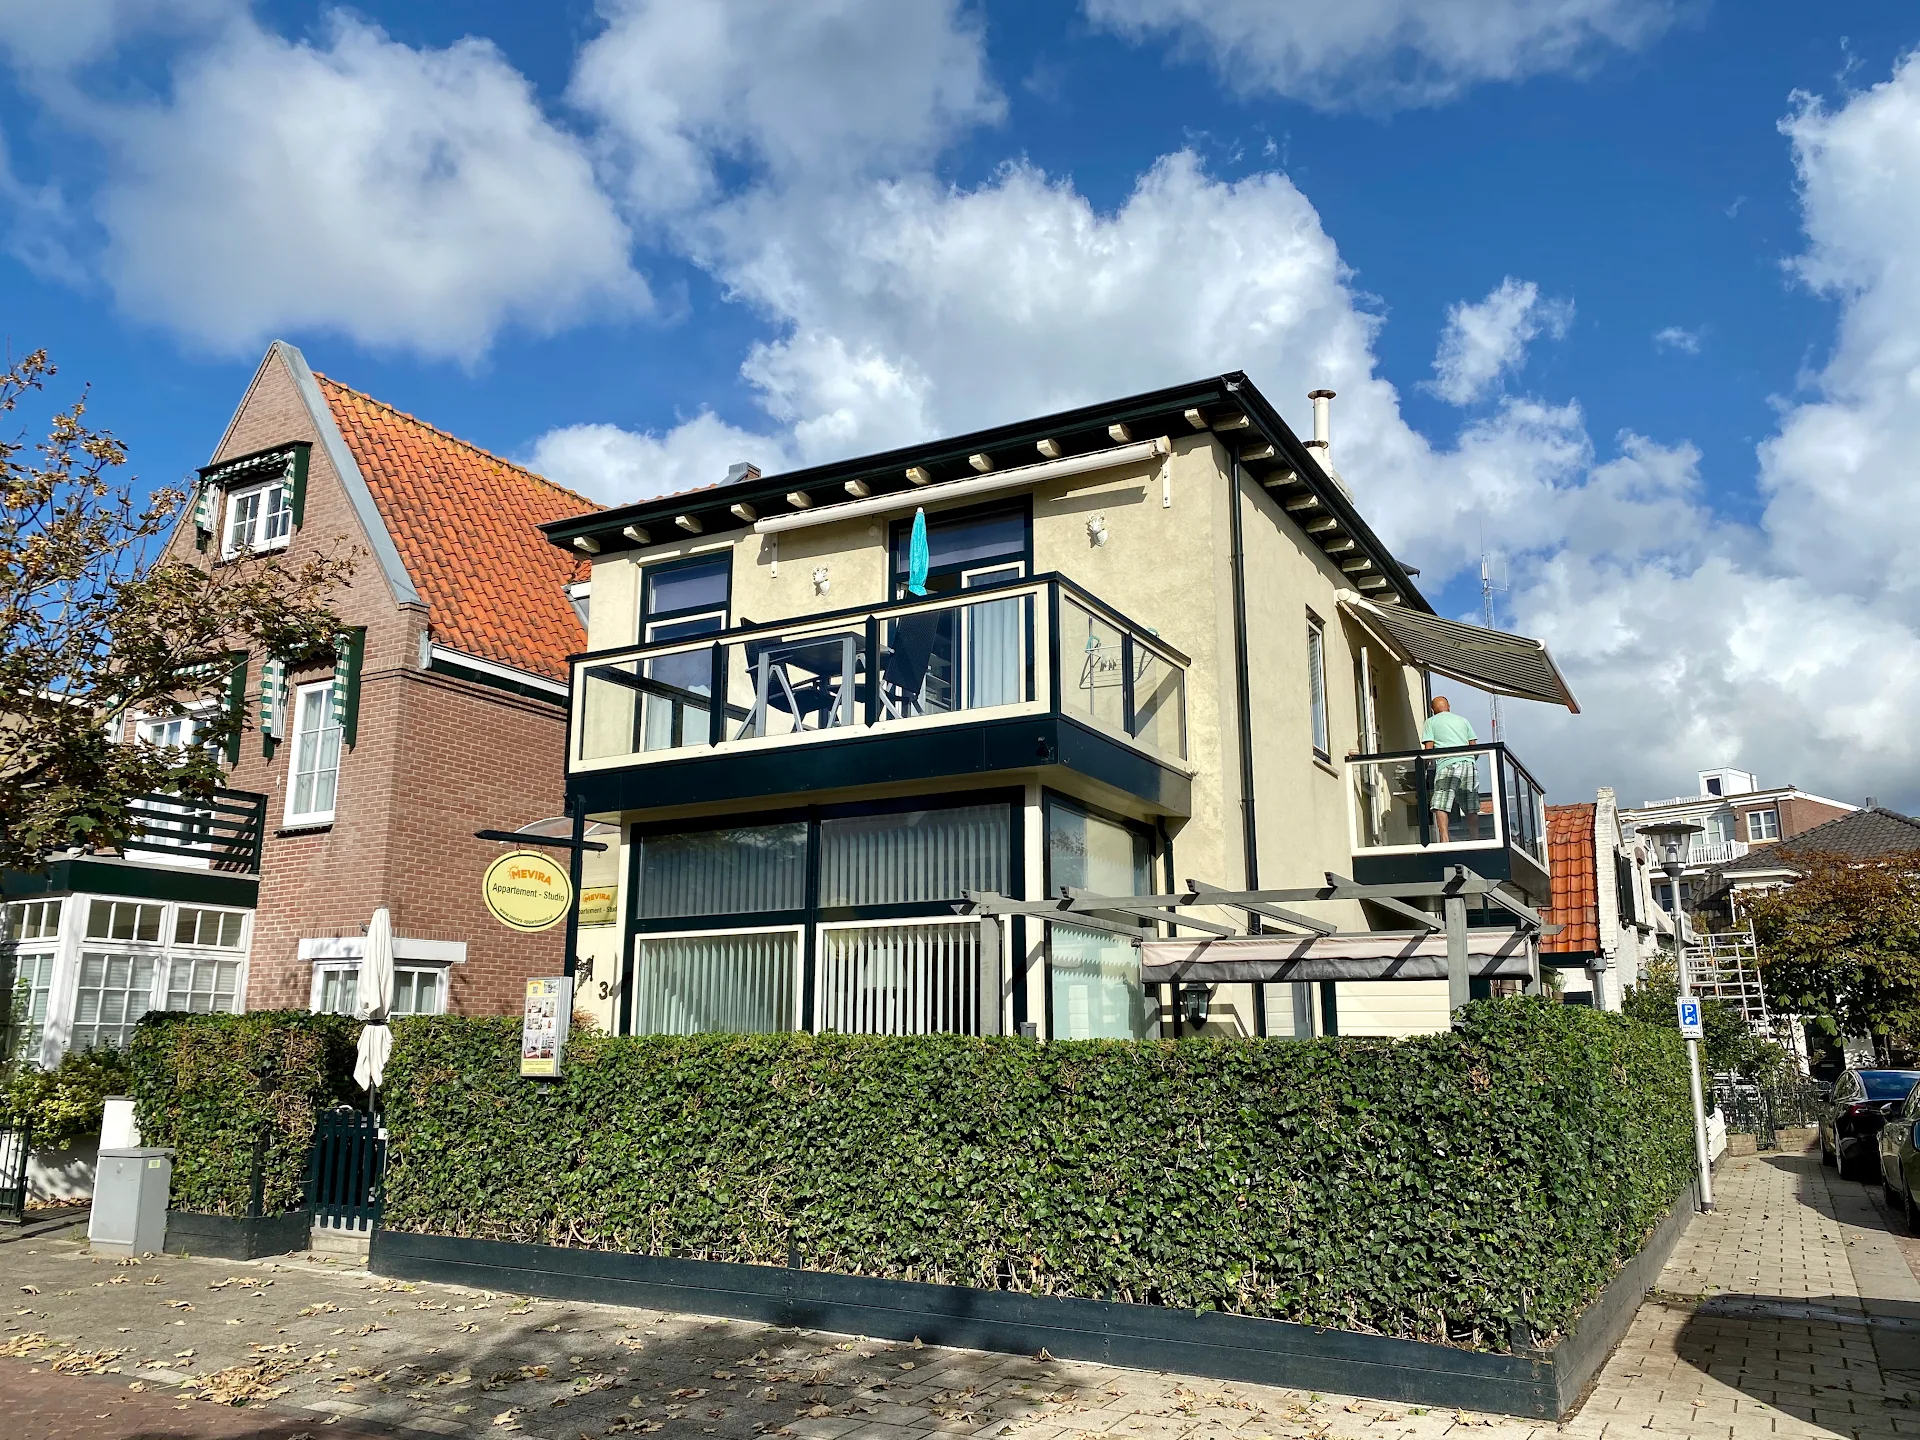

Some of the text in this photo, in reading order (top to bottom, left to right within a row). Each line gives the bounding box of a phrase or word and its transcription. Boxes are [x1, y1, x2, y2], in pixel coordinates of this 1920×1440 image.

[511, 869, 552, 886] MEVIRA
[492, 883, 538, 898] Appartement
[543, 891, 565, 902] Studio
[584, 893, 611, 902] MEVIRA
[606, 905, 618, 913] Stud
[1684, 1005, 1694, 1016] P
